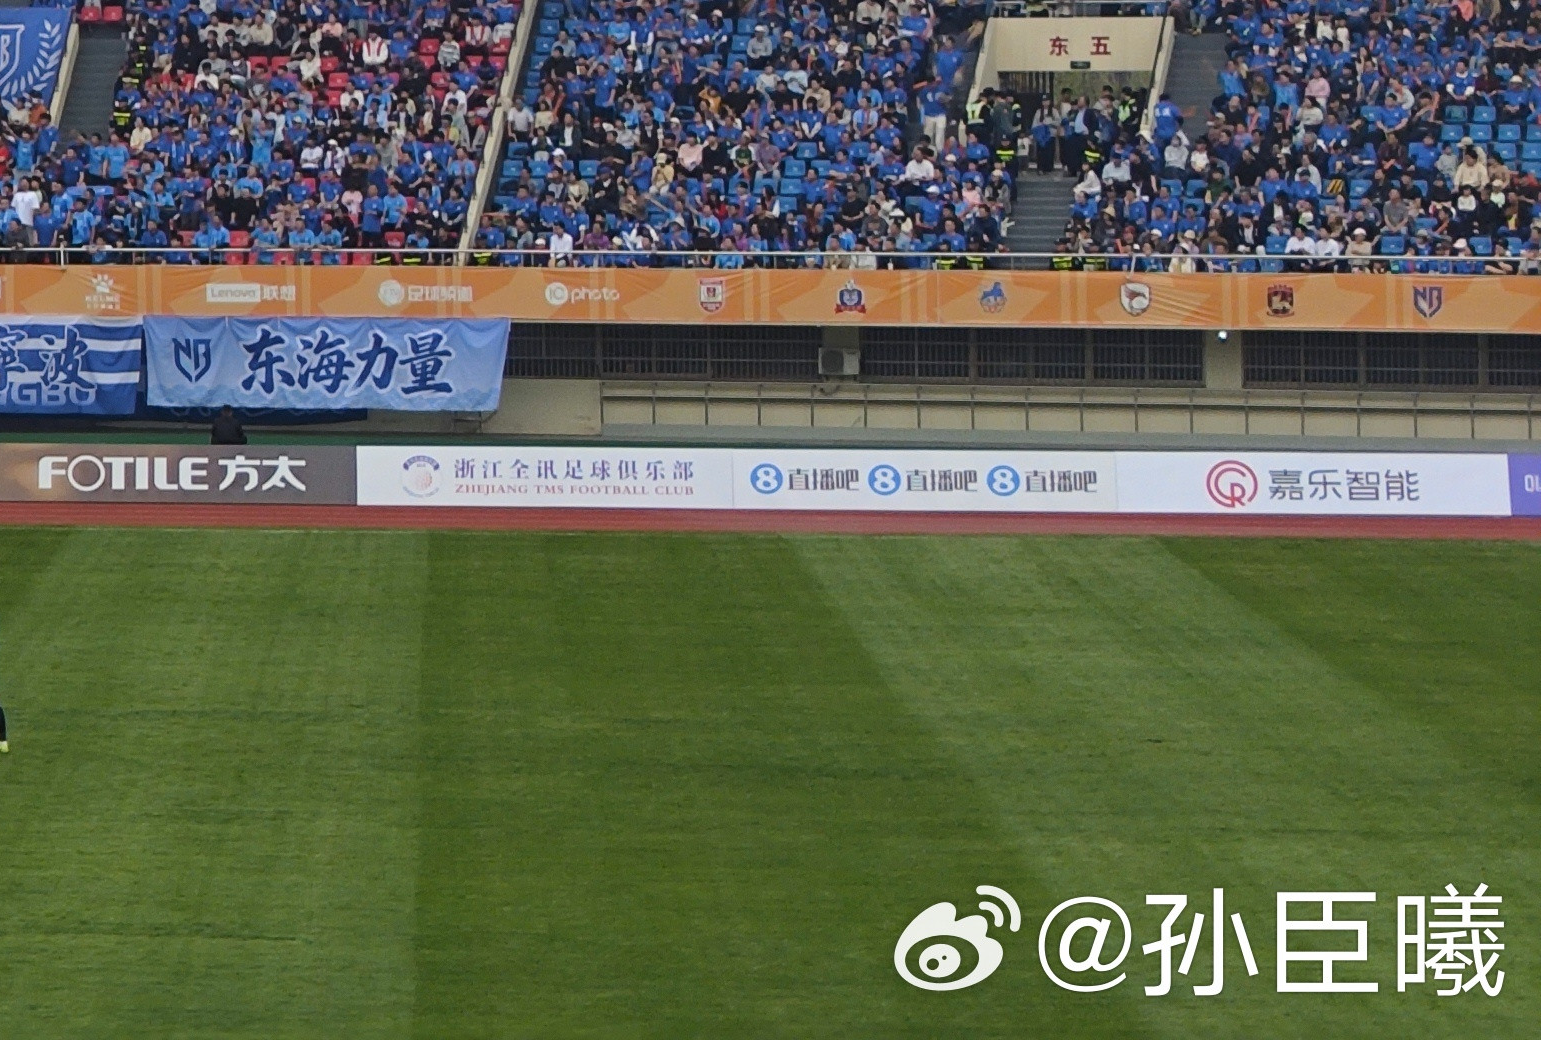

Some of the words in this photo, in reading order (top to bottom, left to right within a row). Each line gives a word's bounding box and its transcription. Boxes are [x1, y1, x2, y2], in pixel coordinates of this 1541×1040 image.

[1049, 36, 1112, 56] 东五
[239, 328, 455, 396] 东海力量
[37, 453, 209, 492] FOTILE
[218, 454, 307, 493] 方太
[453, 458, 695, 482] 浙江全讯足球俱乐部
[787, 468, 860, 492] 直播吧
[905, 469, 978, 493] 直播吧
[1025, 469, 1098, 493] 直播吧
[454, 484, 529, 496] ZHEJIANG
[534, 484, 565, 495] TMS
[569, 485, 650, 496] FOOTBALL
[654, 485, 695, 497] CLUB
[1268, 468, 1421, 501] 嘉乐智能
